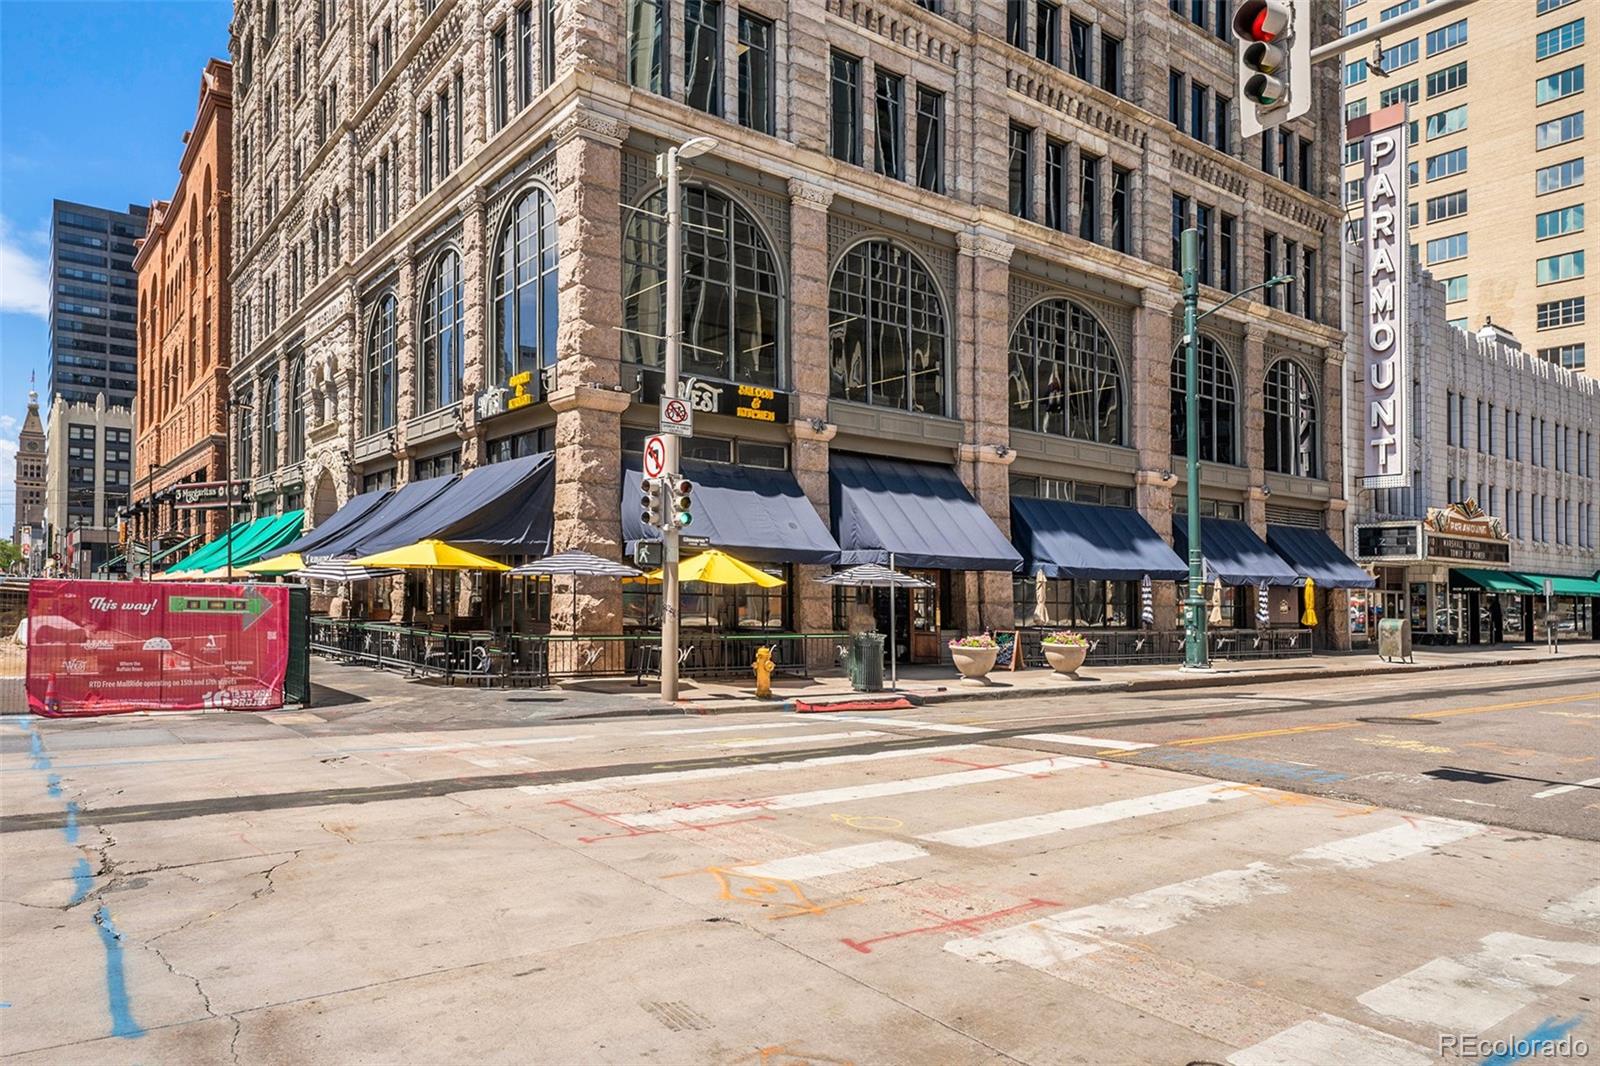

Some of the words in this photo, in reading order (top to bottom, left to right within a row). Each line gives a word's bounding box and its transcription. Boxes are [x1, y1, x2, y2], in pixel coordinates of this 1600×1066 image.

[1369, 135, 1395, 466] PARAMOUNT
[738, 384, 774, 400] SALOON
[751, 398, 761, 409] &
[737, 407, 775, 421] KITCHEN
[1450, 522, 1487, 534] PARAMOUNT
[89, 596, 118, 612] This
[121, 598, 158, 616] way!
[143, 680, 172, 688] operating
[180, 678, 193, 686] 15th
[194, 678, 205, 686] and
